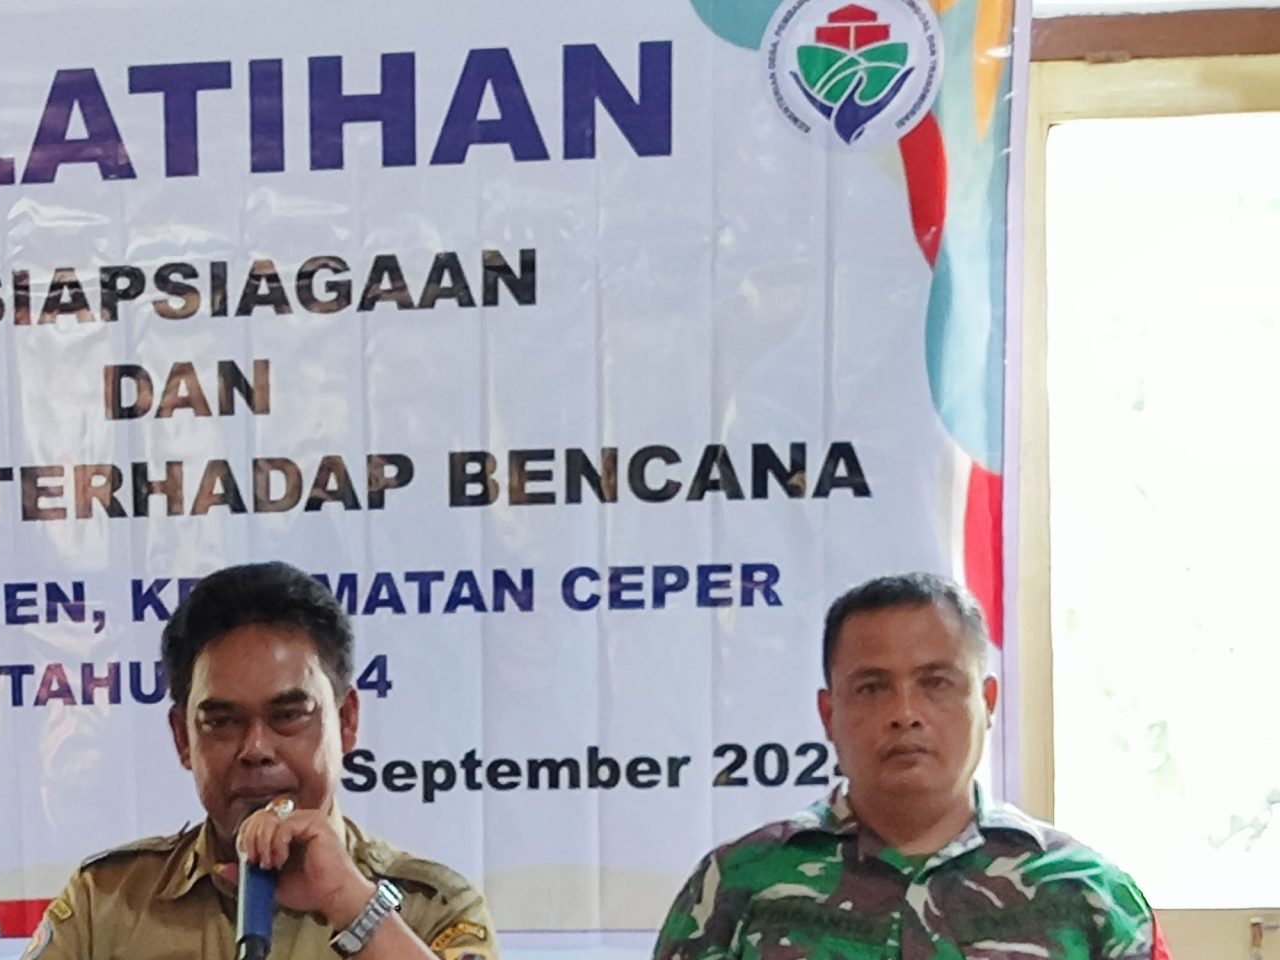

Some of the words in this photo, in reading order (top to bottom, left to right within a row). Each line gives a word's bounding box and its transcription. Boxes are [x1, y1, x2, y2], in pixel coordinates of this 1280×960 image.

[104, 359, 271, 421] DAN
[448, 441, 872, 508] BENCANA
[561, 562, 783, 612] CEPER
[341, 745, 692, 804] September
[712, 742, 843, 787] 202
